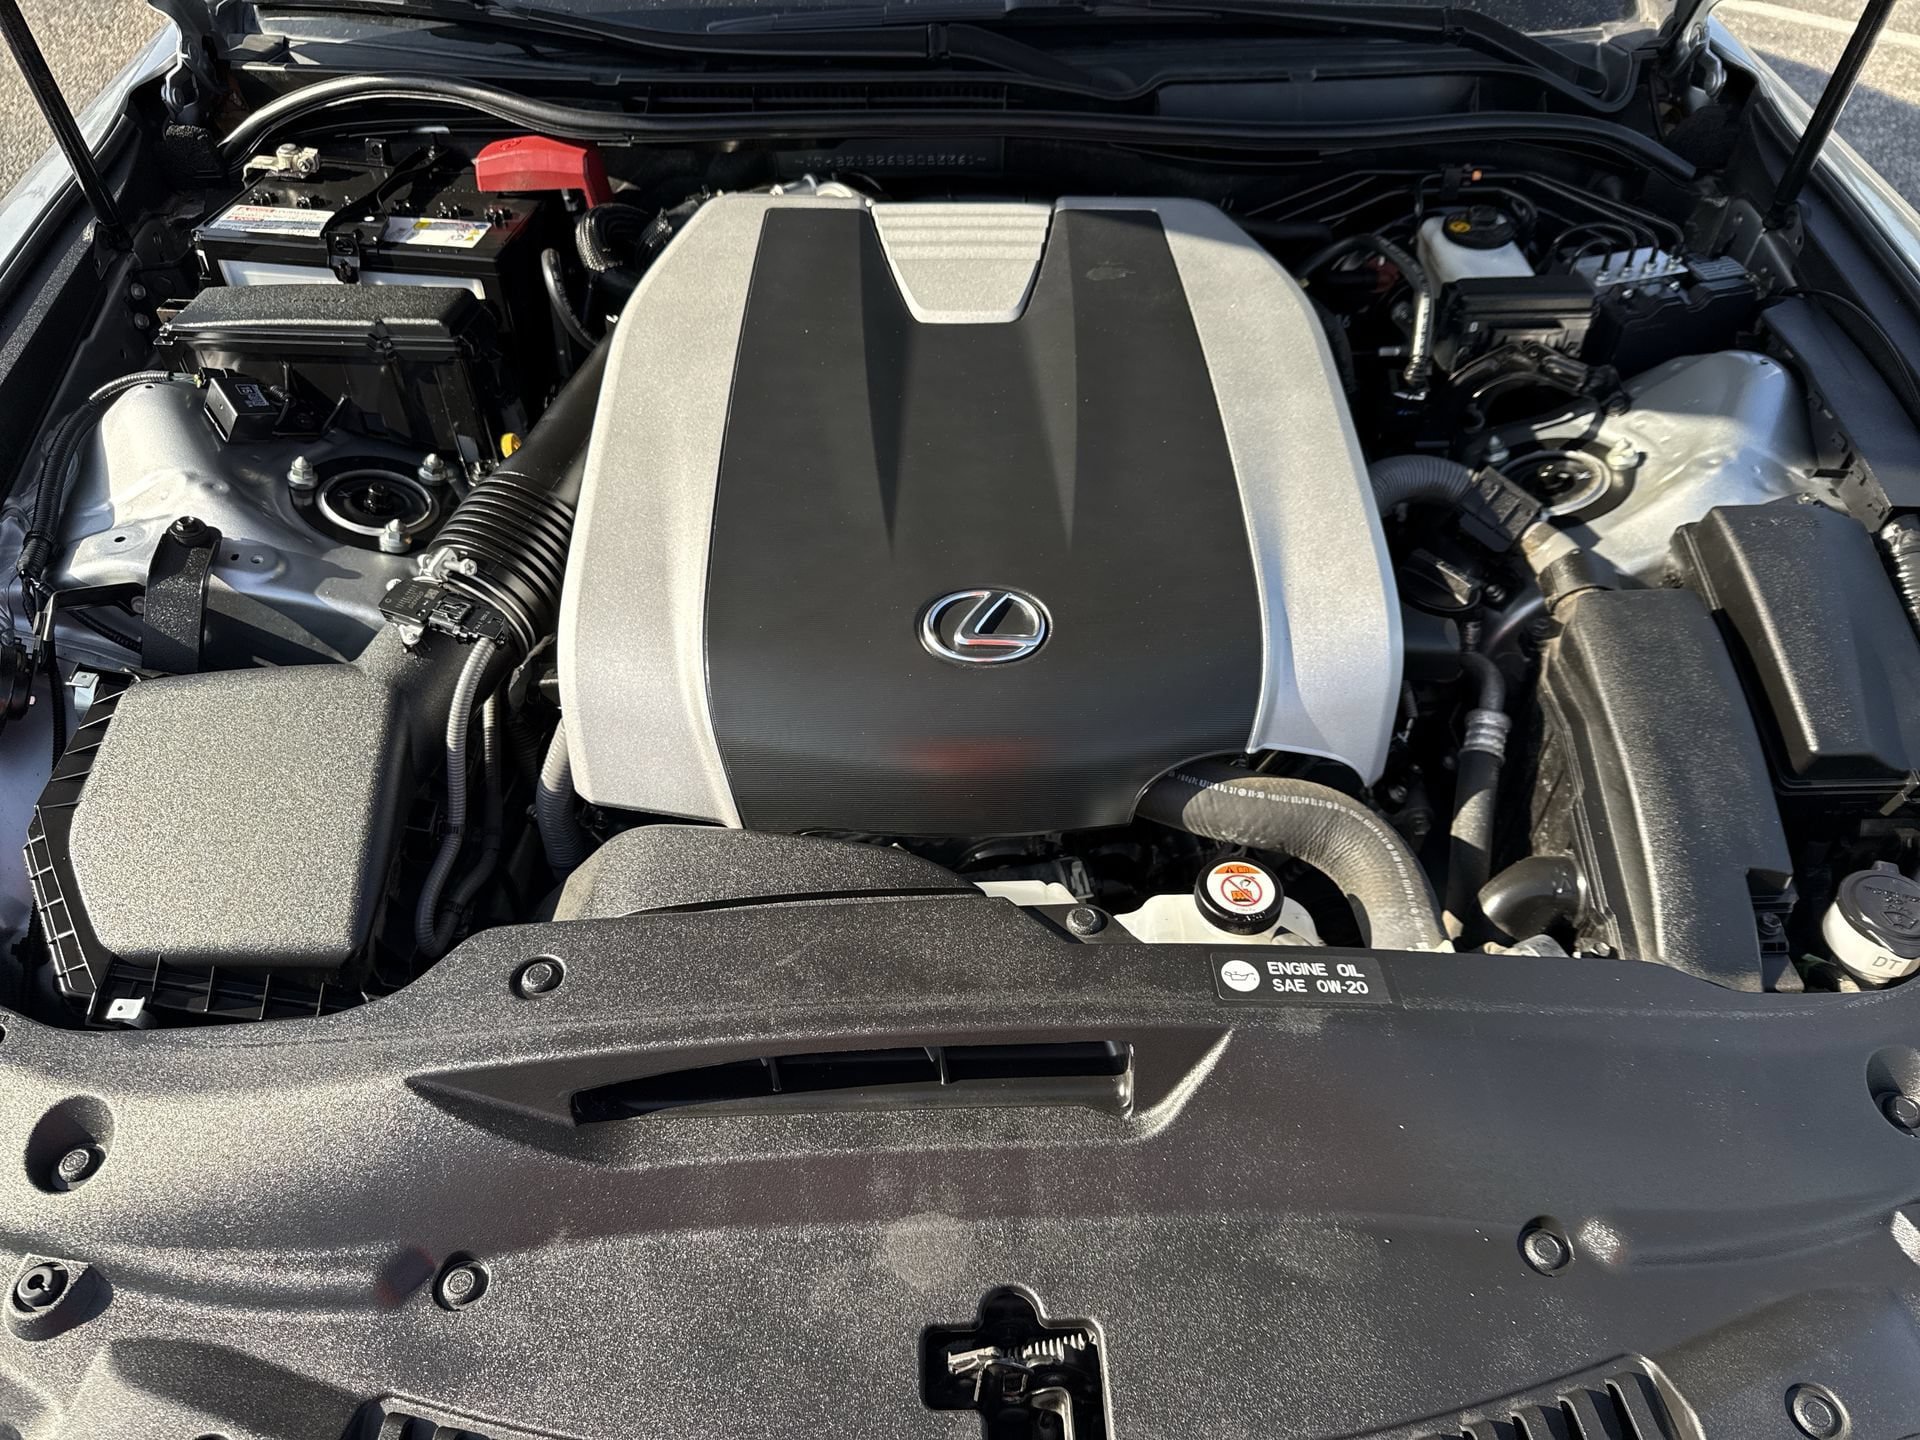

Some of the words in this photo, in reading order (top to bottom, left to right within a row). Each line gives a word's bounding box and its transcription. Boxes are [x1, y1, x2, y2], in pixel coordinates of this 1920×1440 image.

[1267, 961, 1328, 976] ENGINE
[1336, 963, 1365, 978] OIL
[1871, 956, 1902, 970] DT
[1272, 978, 1308, 993] SAE
[1316, 979, 1369, 994] 0W-20
